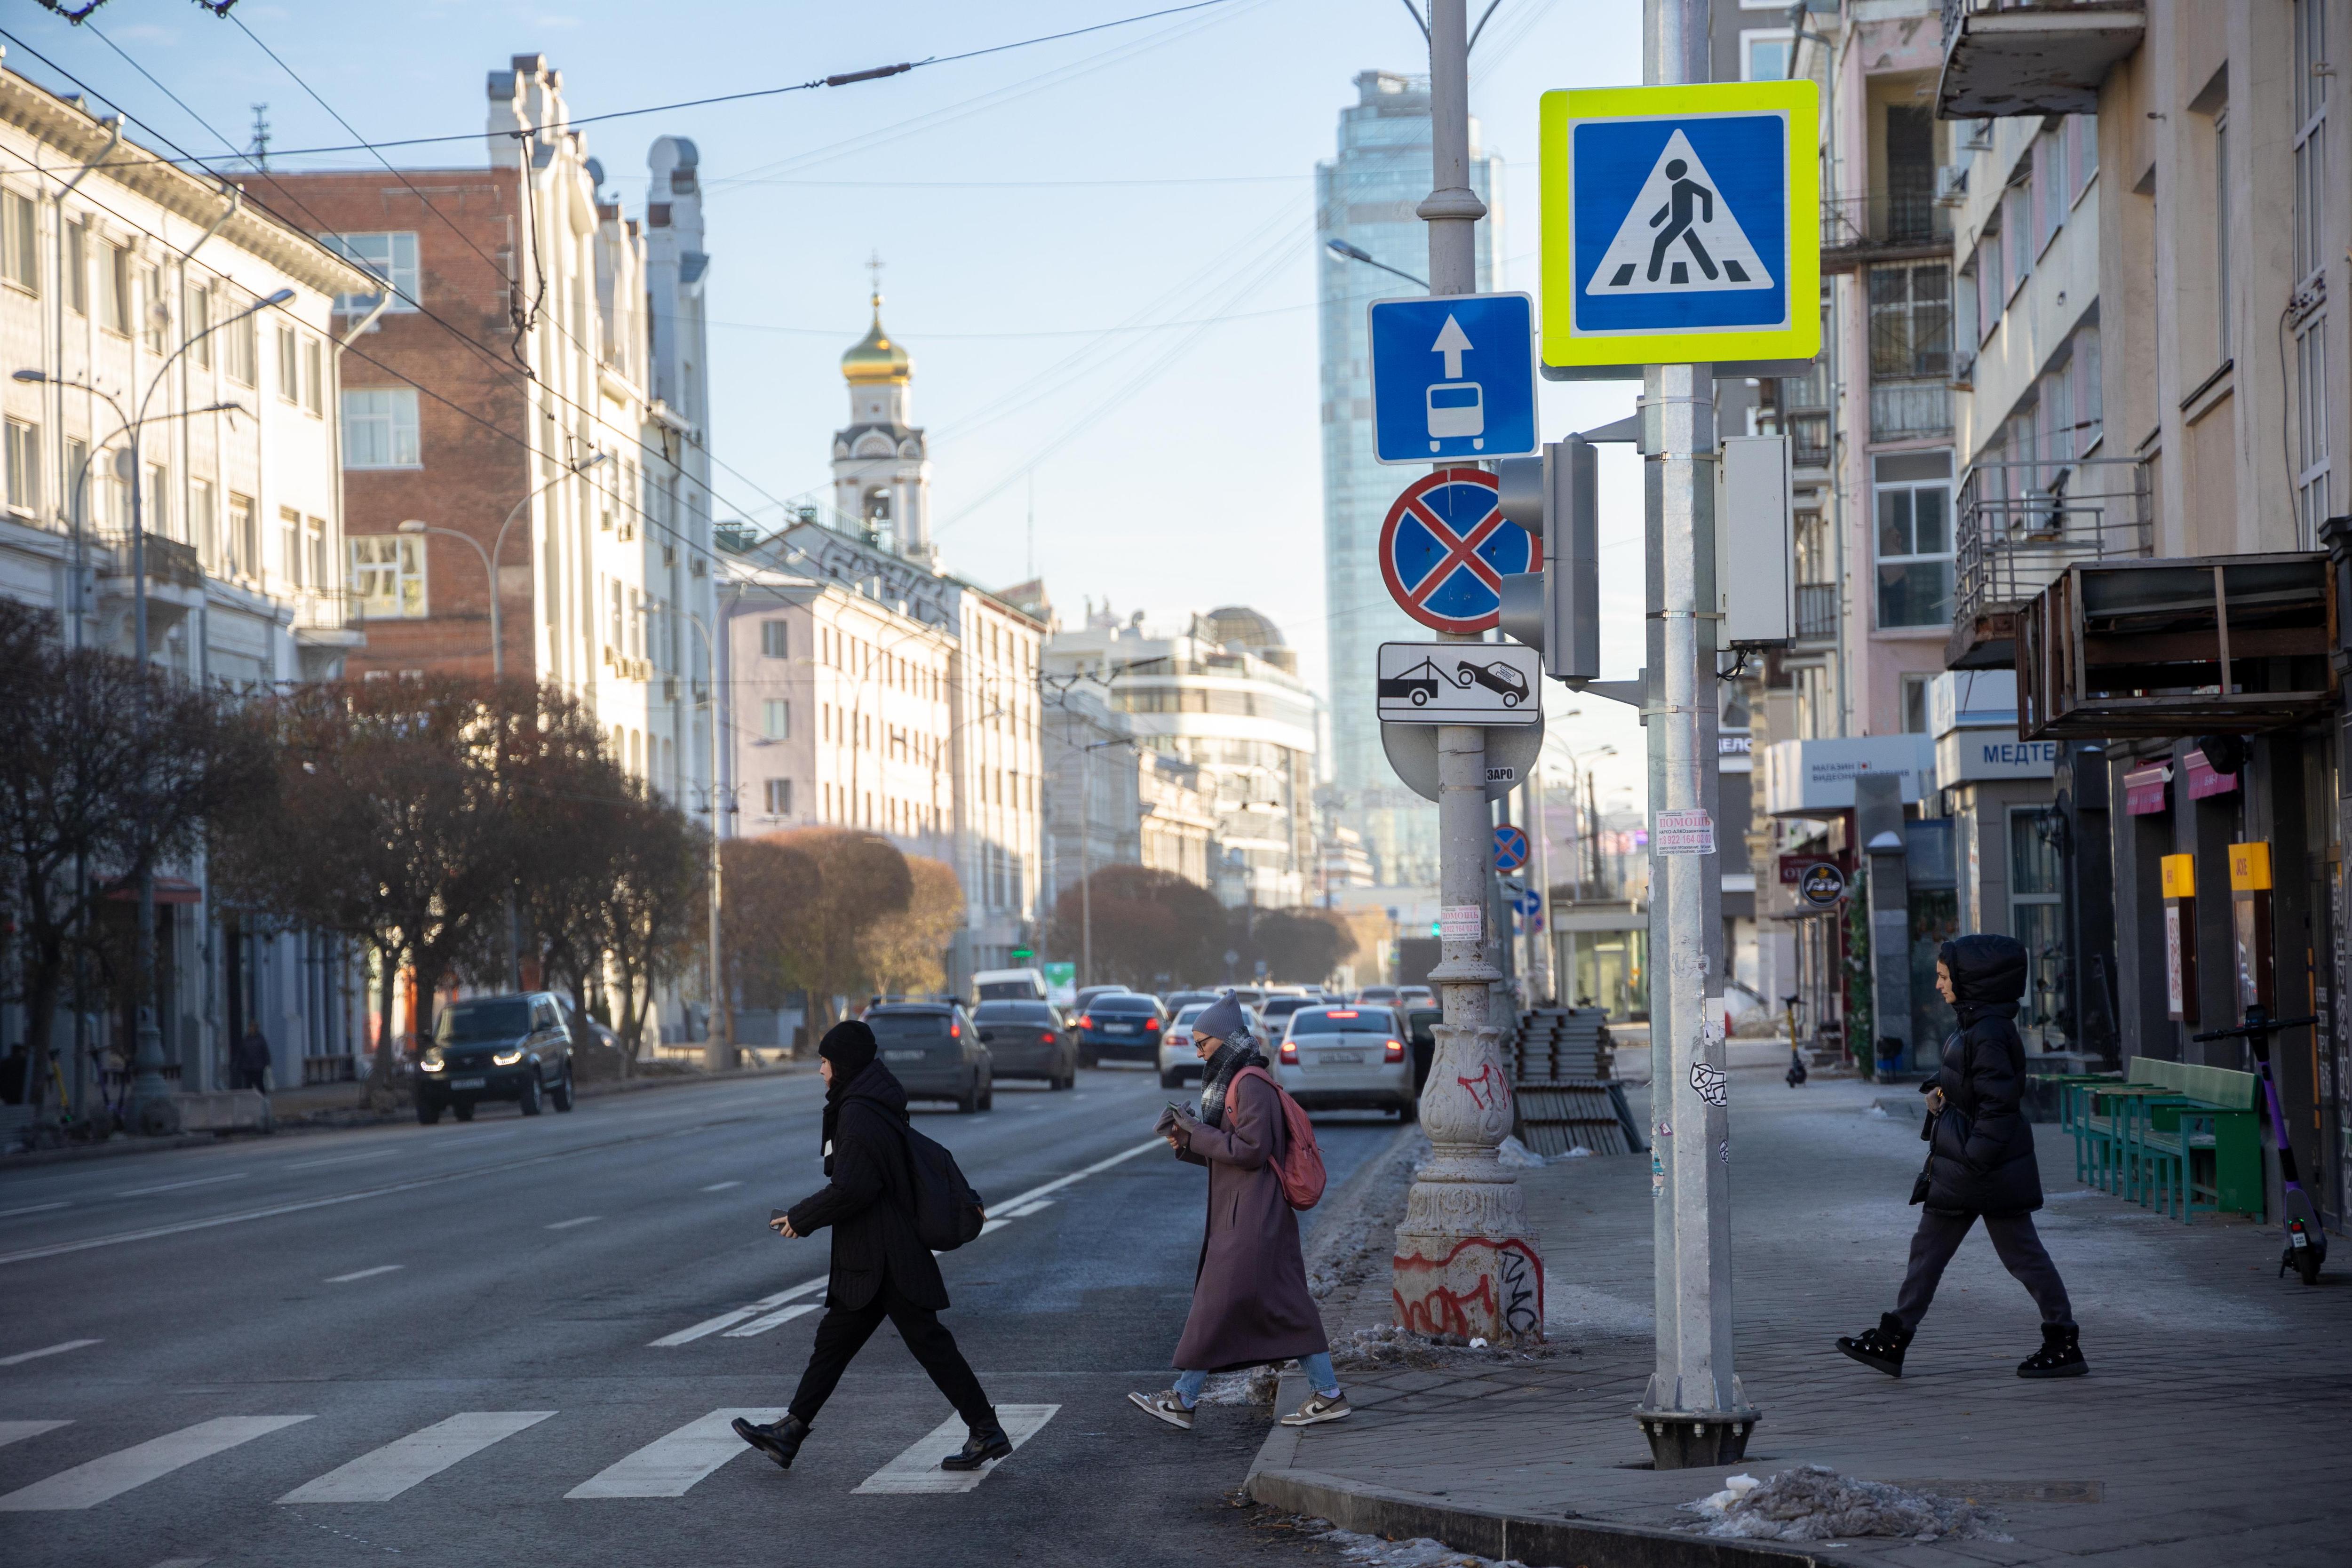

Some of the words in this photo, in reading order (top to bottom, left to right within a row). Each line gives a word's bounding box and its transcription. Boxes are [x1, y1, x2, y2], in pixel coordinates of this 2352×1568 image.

[1812, 763, 1855, 772] МАГАЗИН
[1659, 817, 1710, 828] ПОМОЩЬ
[1668, 835, 1680, 844] 922
[1683, 835, 1694, 844] 164
[1697, 834, 1704, 843] 02
[1705, 834, 1711, 843] 02
